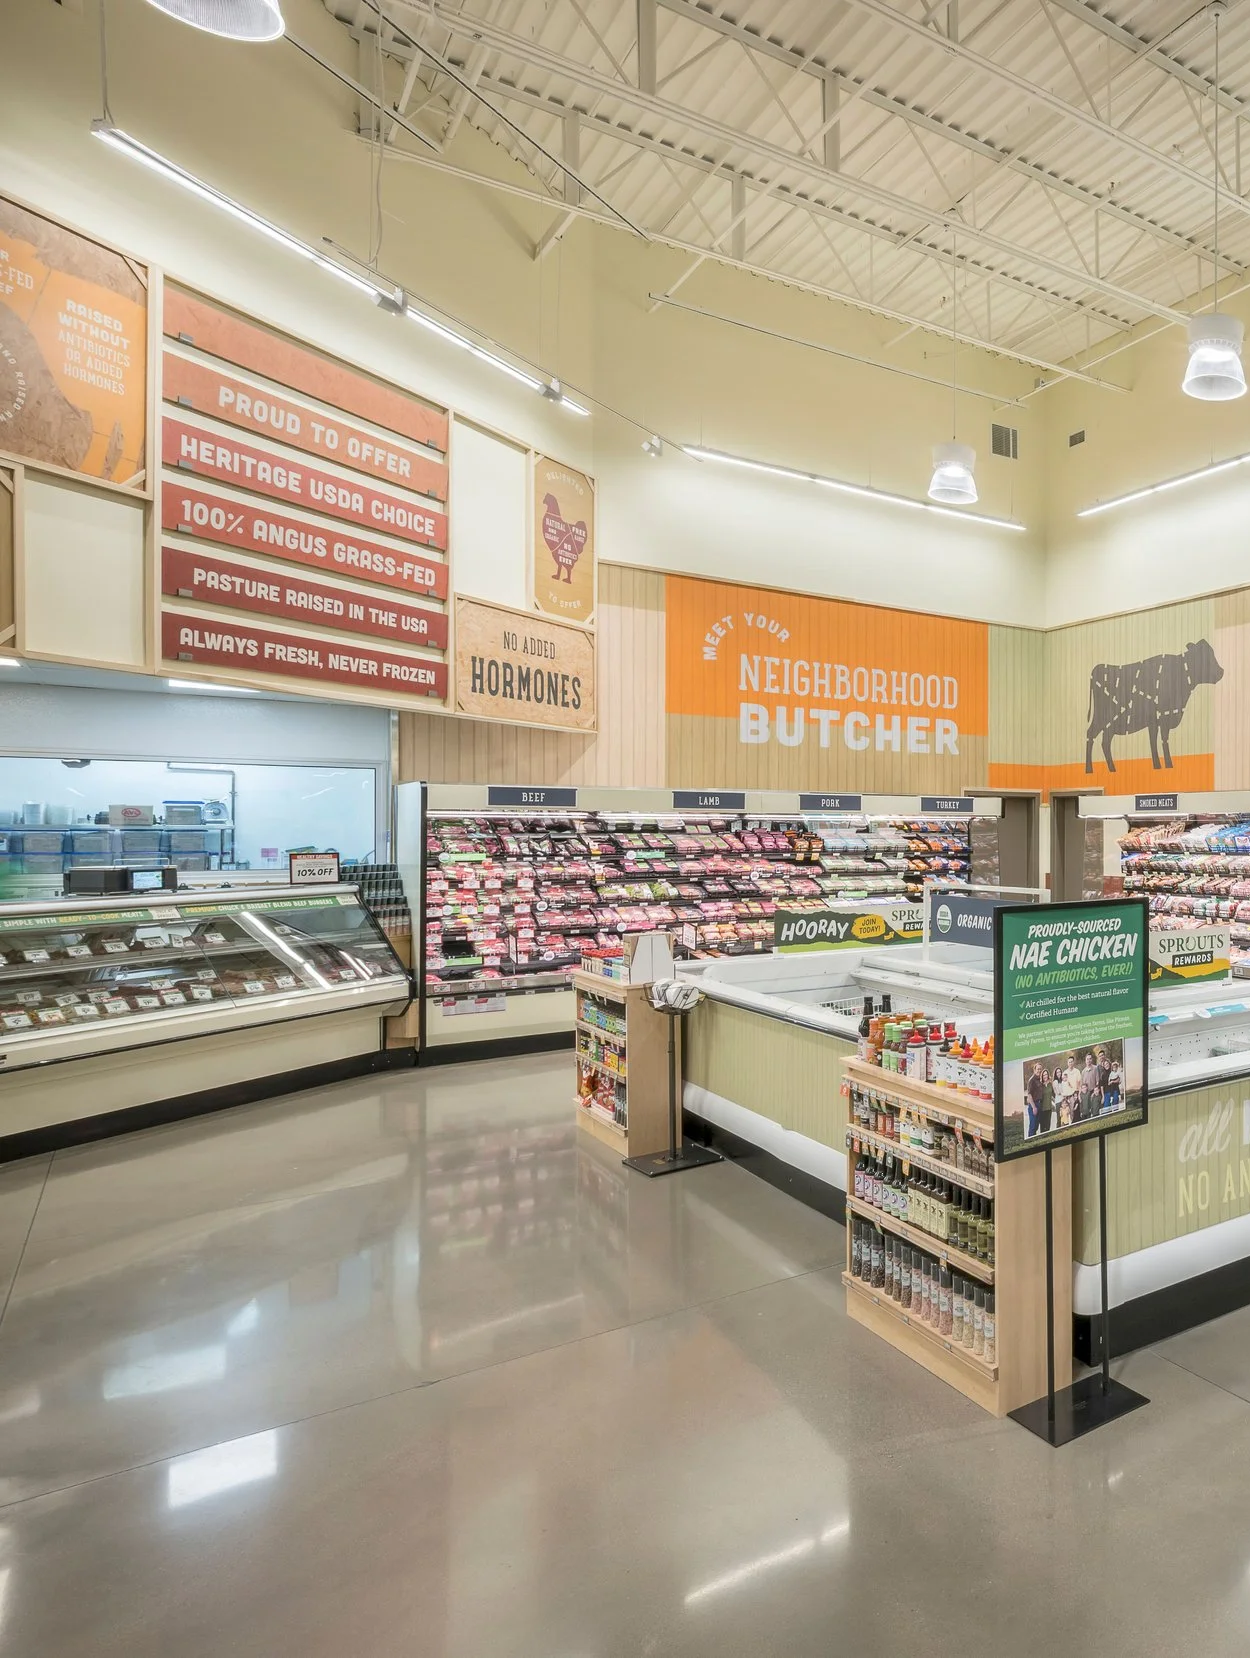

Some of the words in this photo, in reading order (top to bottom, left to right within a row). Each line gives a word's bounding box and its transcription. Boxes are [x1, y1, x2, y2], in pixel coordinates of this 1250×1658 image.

[0, 266, 34, 290] -FED
[66, 298, 123, 333] RAISED
[58, 312, 130, 350] WITHOUT
[58, 329, 131, 368] ANTIBIOTICS
[66, 348, 81, 364] OR
[86, 356, 123, 380] ADDED
[63, 363, 125, 396] HORMONES
[218, 386, 300, 435] PROUD
[310, 421, 339, 450] TO
[347, 439, 412, 478] OFFER
[180, 434, 302, 494] HERITAGE
[310, 478, 364, 514] USDA
[371, 500, 436, 537] CHOICE
[546, 518, 566, 533] NATURAL
[572, 526, 586, 538] FREE
[181, 499, 244, 535] 100%
[253, 519, 327, 557] ANGUS
[333, 543, 436, 587] GRASS-FED
[564, 543, 572, 551] NO
[559, 555, 573, 566] EVER
[193, 567, 280, 603] PASTURE
[285, 590, 344, 616] RAISED
[349, 603, 364, 621] IN
[369, 607, 397, 628] THE
[401, 615, 428, 635] USA
[503, 630, 518, 652] NO
[523, 636, 556, 660] ADDED
[703, 615, 734, 661] MEET
[743, 612, 791, 643] YOUR
[180, 628, 258, 656] ALWAYS
[264, 642, 323, 669] FRESH,
[328, 653, 378, 676] NEVER
[383, 662, 436, 685] FROZEN
[471, 655, 581, 710] HORMONES
[738, 653, 958, 709] NEIGHBORHOOD
[739, 702, 960, 755] BUTCHER
[522, 792, 546, 802] BEEF
[699, 796, 720, 806] LAMB
[821, 798, 840, 808] PORK
[936, 800, 959, 809] TURKEY
[1139, 799, 1158, 808] SMOKED
[1158, 798, 1174, 807] MEATS
[297, 869, 316, 877] 10%
[317, 868, 334, 876] OFF
[185, 905, 217, 913] PREMIUM
[218, 903, 239, 911] CHUCK
[892, 909, 924, 922] SPRO
[4, 917, 34, 928] SIMPLE
[36, 916, 57, 925] WITH
[121, 910, 144, 919] MEATS
[861, 917, 877, 926] JOIN
[957, 914, 992, 930] ORGANIC
[1028, 918, 1121, 938] PROUDLY-SOURCED
[780, 919, 849, 941] HOORAY
[859, 926, 881, 935] TODAY!
[1010, 940, 1052, 970] NAE
[1056, 933, 1138, 965] CHICKEN
[1158, 934, 1224, 953] SPROUTS
[1174, 953, 1212, 966] REWARDS
[1015, 974, 1033, 989] (NO
[1035, 967, 1098, 986] ANTIBIOTICS,
[1102, 962, 1133, 978] EVER!)
[1026, 1000, 1035, 1008] Air
[1036, 997, 1056, 1007] chilled
[1057, 996, 1066, 1004] for
[1067, 994, 1077, 1002] the
[1078, 993, 1090, 1001] best
[1091, 990, 1111, 998] natural
[1026, 1009, 1052, 1020] Certified
[1053, 1006, 1078, 1016] Humane
[1179, 1098, 1234, 1163] all
[1178, 1170, 1209, 1218] NO
